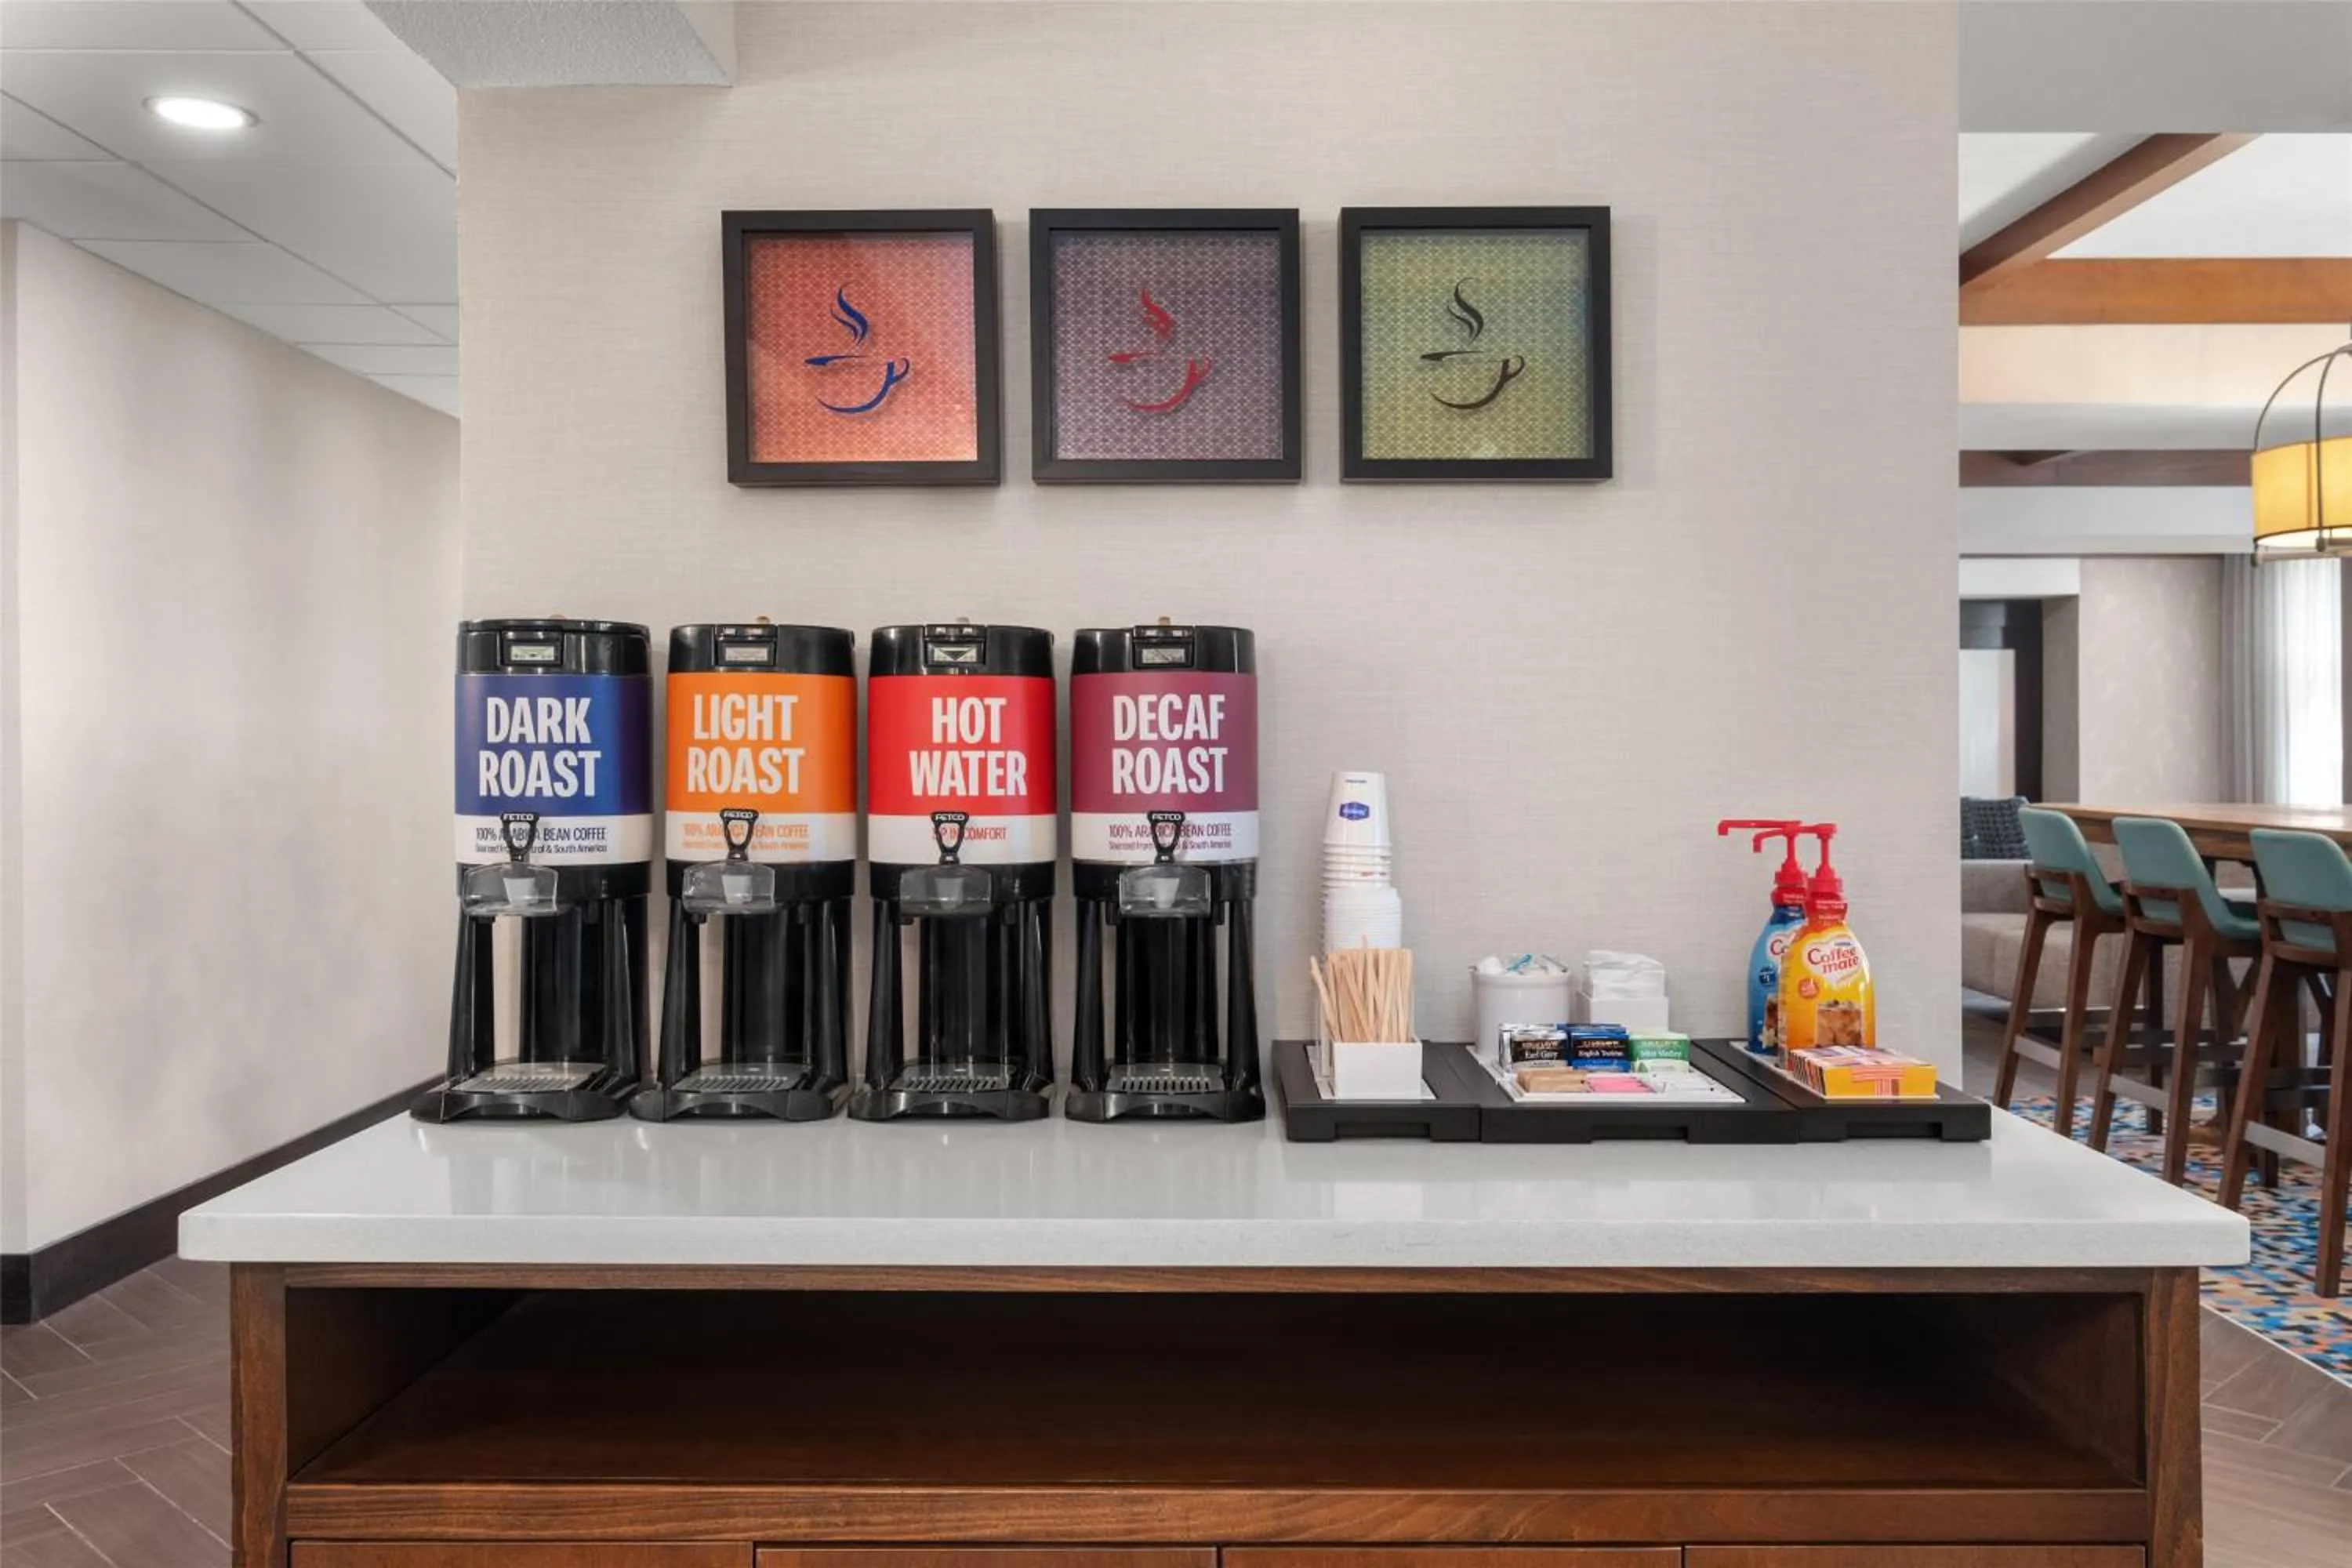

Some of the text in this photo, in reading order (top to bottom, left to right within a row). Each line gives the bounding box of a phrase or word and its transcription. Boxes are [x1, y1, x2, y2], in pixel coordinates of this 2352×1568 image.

[486, 697, 592, 744] DARK
[693, 694, 798, 741] LIGHT
[931, 697, 1007, 744] HOT
[1112, 694, 1225, 741] DECAF
[478, 750, 601, 798] ROAST
[688, 747, 805, 794] ROAST
[909, 750, 1028, 797] WATER
[1112, 747, 1229, 794] ROAST
[476, 827, 496, 841] 100%
[543, 828, 571, 841] BEAN
[573, 828, 607, 840] COFFEE
[964, 827, 1006, 840] COMFORT
[1109, 824, 1133, 838] 100%
[1207, 823, 1232, 837] COFFEE
[1807, 946, 1857, 965] Coffee
[1822, 956, 1859, 974] mate
